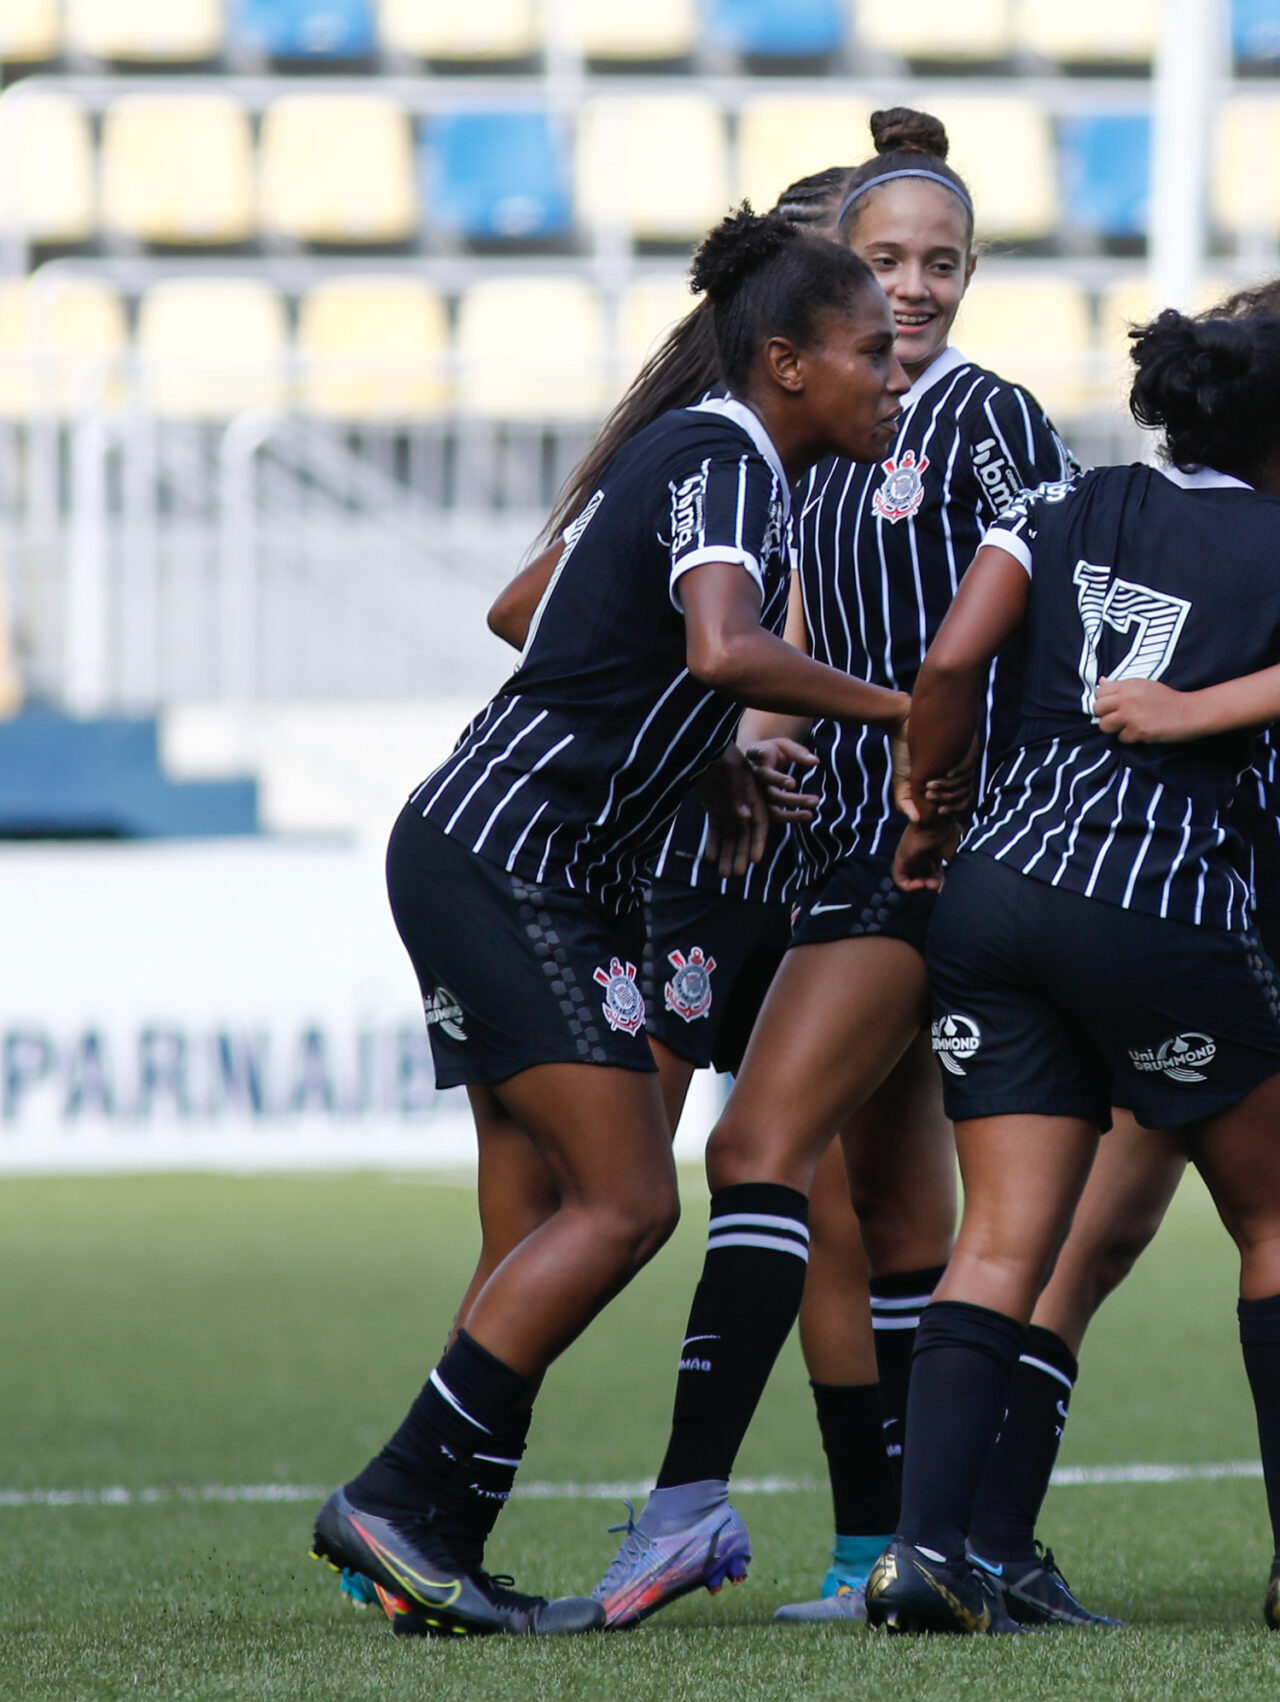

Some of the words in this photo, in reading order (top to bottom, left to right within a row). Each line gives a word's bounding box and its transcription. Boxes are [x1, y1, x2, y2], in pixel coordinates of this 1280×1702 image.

[979, 457, 1014, 513] bm
[672, 487, 702, 554] bmg
[1128, 1048, 1154, 1061] Uni
[1133, 1043, 1216, 1071] DRUMMOND
